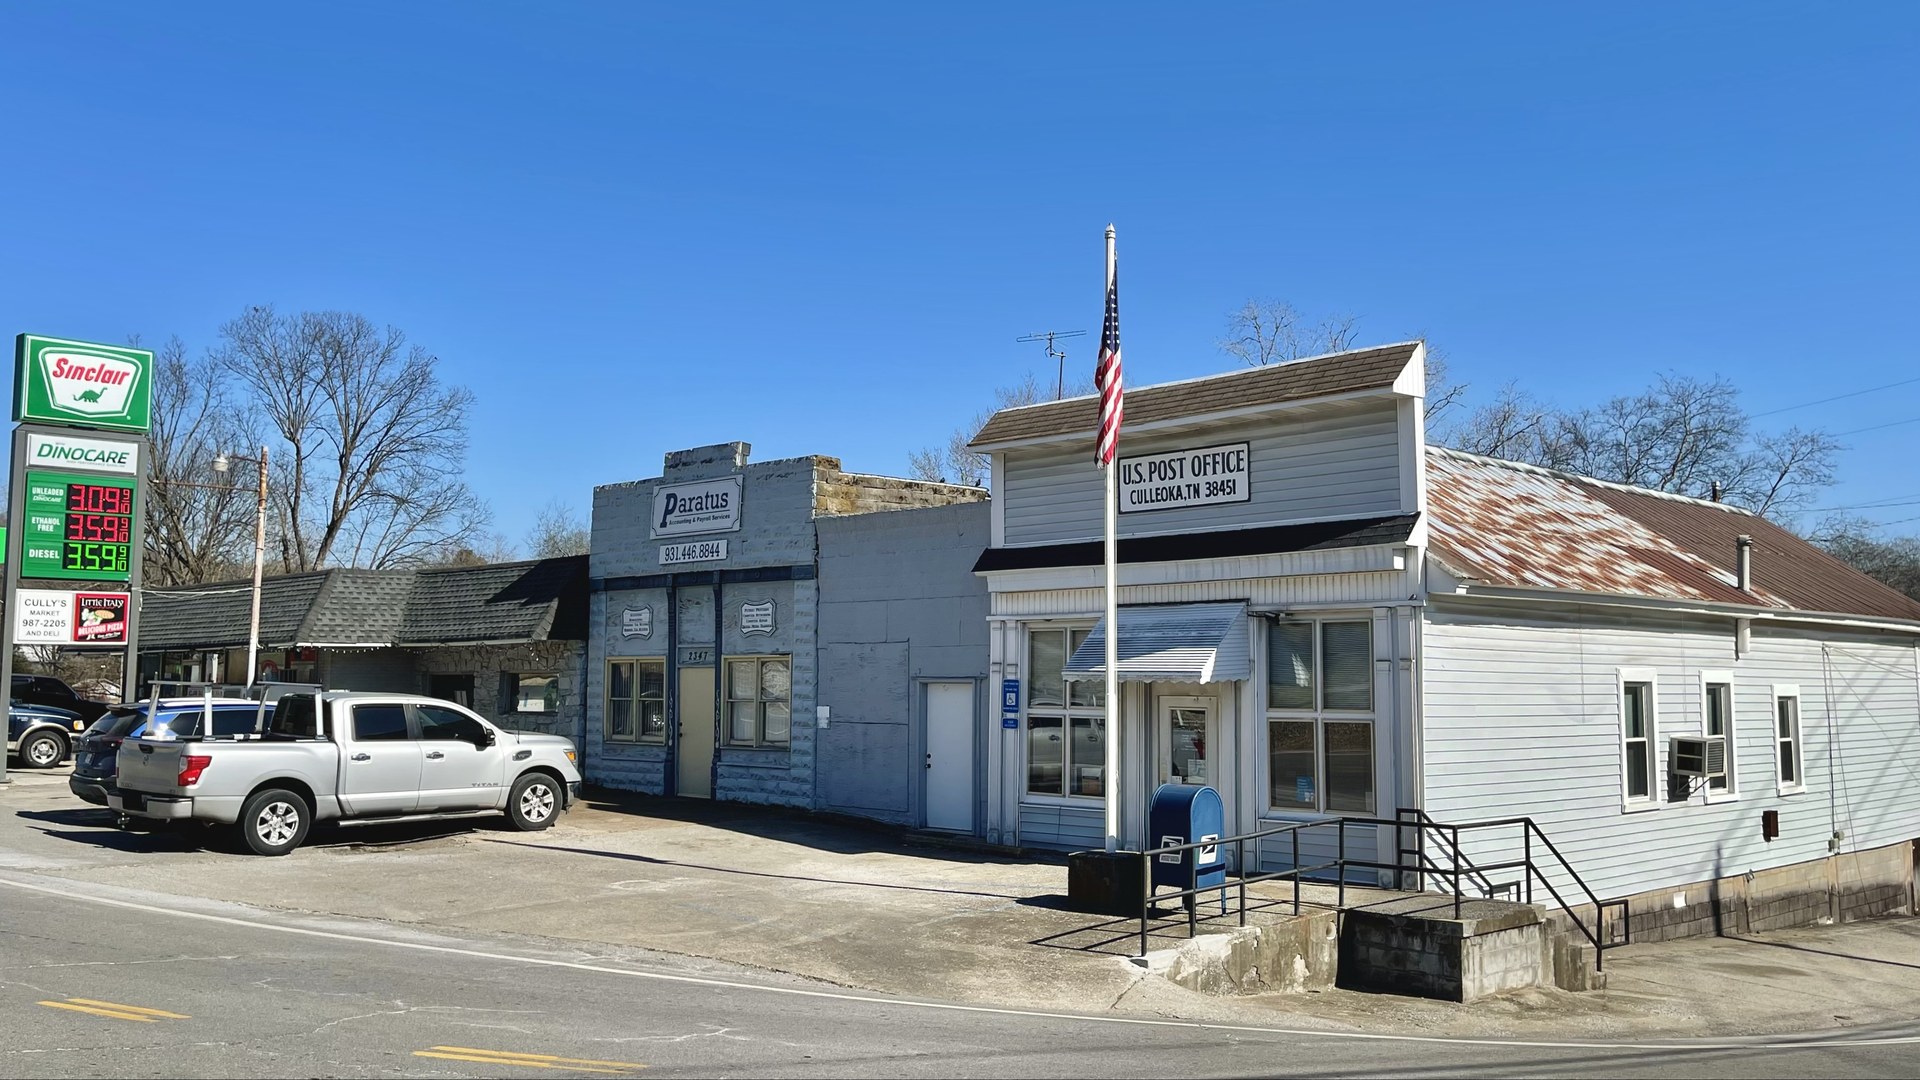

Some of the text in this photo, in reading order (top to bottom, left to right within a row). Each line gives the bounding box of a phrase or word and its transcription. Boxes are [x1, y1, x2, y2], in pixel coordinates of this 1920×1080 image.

[52, 357, 130, 386] Sinclair
[37, 443, 130, 464] DINOCARE
[1122, 449, 1245, 485] U.S. POST OFFICE
[32, 486, 64, 496] UNLEADED
[1205, 478, 1236, 498] 38451
[70, 484, 120, 513] 3.09
[660, 491, 729, 528] Paratus
[31, 516, 61, 525] ETHANOL
[37, 524, 54, 532] FREE
[69, 513, 119, 542] 3.59
[28, 549, 60, 559] DIESEL
[67, 543, 117, 571] 3.59
[664, 542, 720, 561] 931.446.8844
[24, 598, 67, 607] CULLY'S
[22, 619, 66, 627] 987-2205
